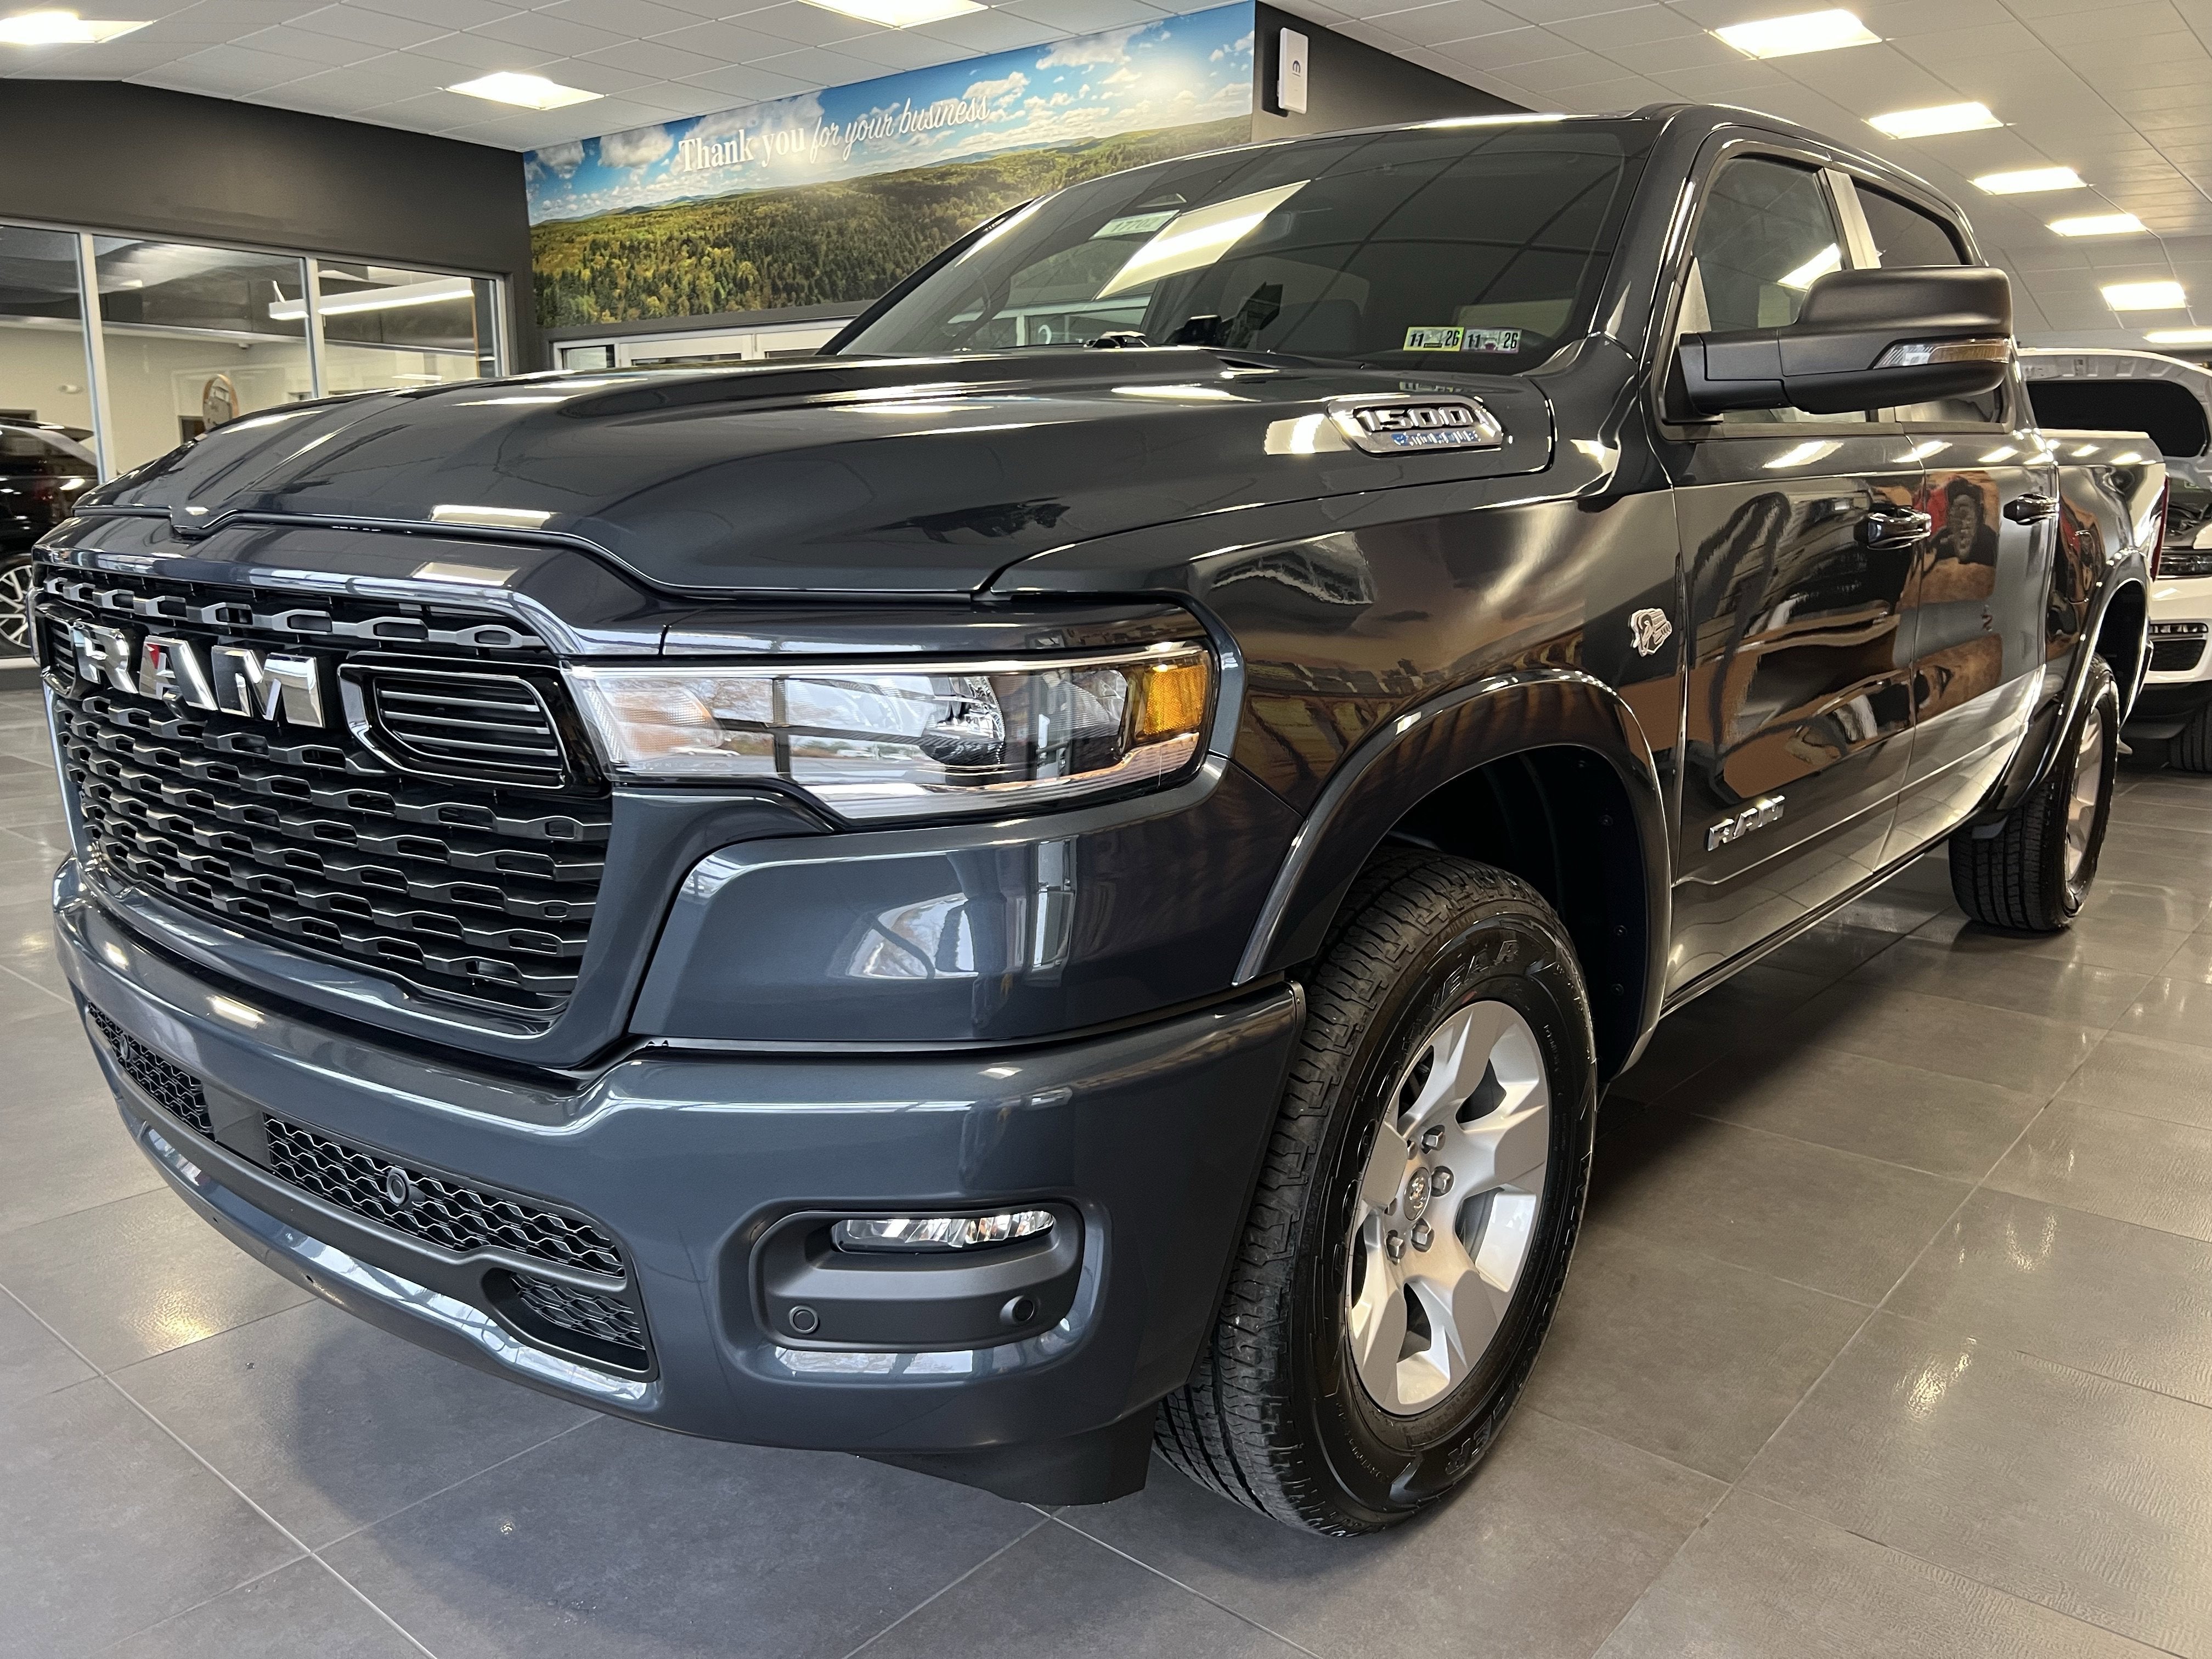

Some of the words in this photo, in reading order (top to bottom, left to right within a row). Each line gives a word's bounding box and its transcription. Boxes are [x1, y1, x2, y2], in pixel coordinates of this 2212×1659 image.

[679, 129, 754, 172] Thank
[762, 128, 805, 167] you
[810, 116, 841, 163] for
[843, 114, 894, 161] your
[899, 96, 990, 134] business
[1410, 334, 1424, 347] 11
[1444, 330, 1460, 346] 26
[1468, 334, 1481, 348] 11
[1503, 332, 1518, 349] 26
[1357, 406, 1474, 431] 1500
[70, 619, 326, 729] RAM
[1707, 795, 1785, 851] RAM
